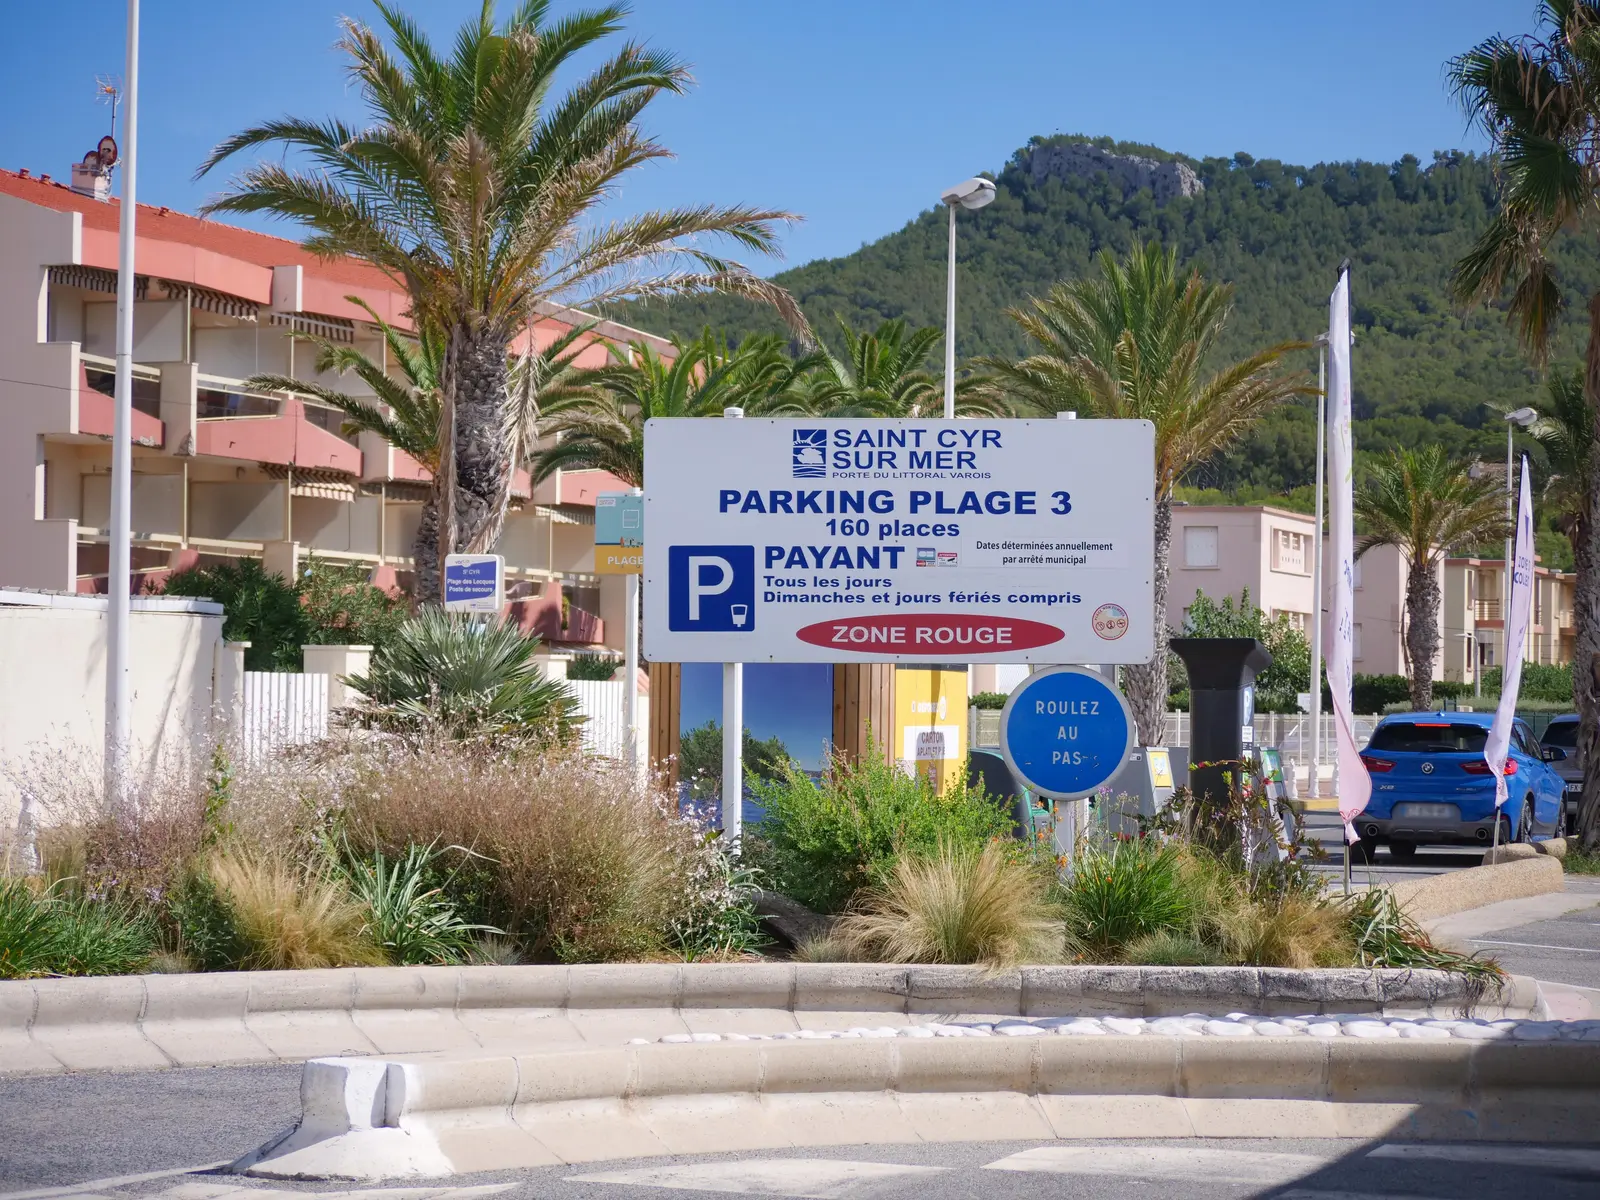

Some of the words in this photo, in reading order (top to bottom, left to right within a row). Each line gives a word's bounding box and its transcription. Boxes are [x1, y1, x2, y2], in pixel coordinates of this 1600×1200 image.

[833, 429, 926, 448] SAINT
[938, 430, 1002, 448] CYR
[833, 451, 897, 469] SUR
[910, 451, 977, 469] MER
[720, 490, 894, 513] PARKING
[910, 491, 1036, 514] PLAGE
[1051, 491, 1071, 515] 3
[826, 519, 869, 536] 160
[879, 520, 959, 540] places
[977, 541, 999, 549] Dates
[1002, 541, 1053, 550] déterminées
[1056, 542, 1112, 550] annuellement
[765, 546, 905, 569] PAYANT
[1003, 557, 1016, 565] par
[1019, 555, 1043, 563] arrêté
[1046, 555, 1086, 565] municipal
[689, 556, 733, 620] P
[763, 576, 806, 587] Tous
[814, 576, 839, 587] les
[845, 576, 892, 590] jours
[764, 589, 865, 603] Dimanches
[872, 593, 889, 603] et
[895, 592, 941, 606] jours
[949, 592, 1000, 603] fériés
[1008, 592, 1081, 605] compris
[832, 626, 905, 643] ZONE
[916, 627, 1012, 643] ROUGE
[1036, 701, 1099, 715] ROULEZ
[1057, 726, 1078, 740] AU
[1052, 751, 1082, 765] PAS
